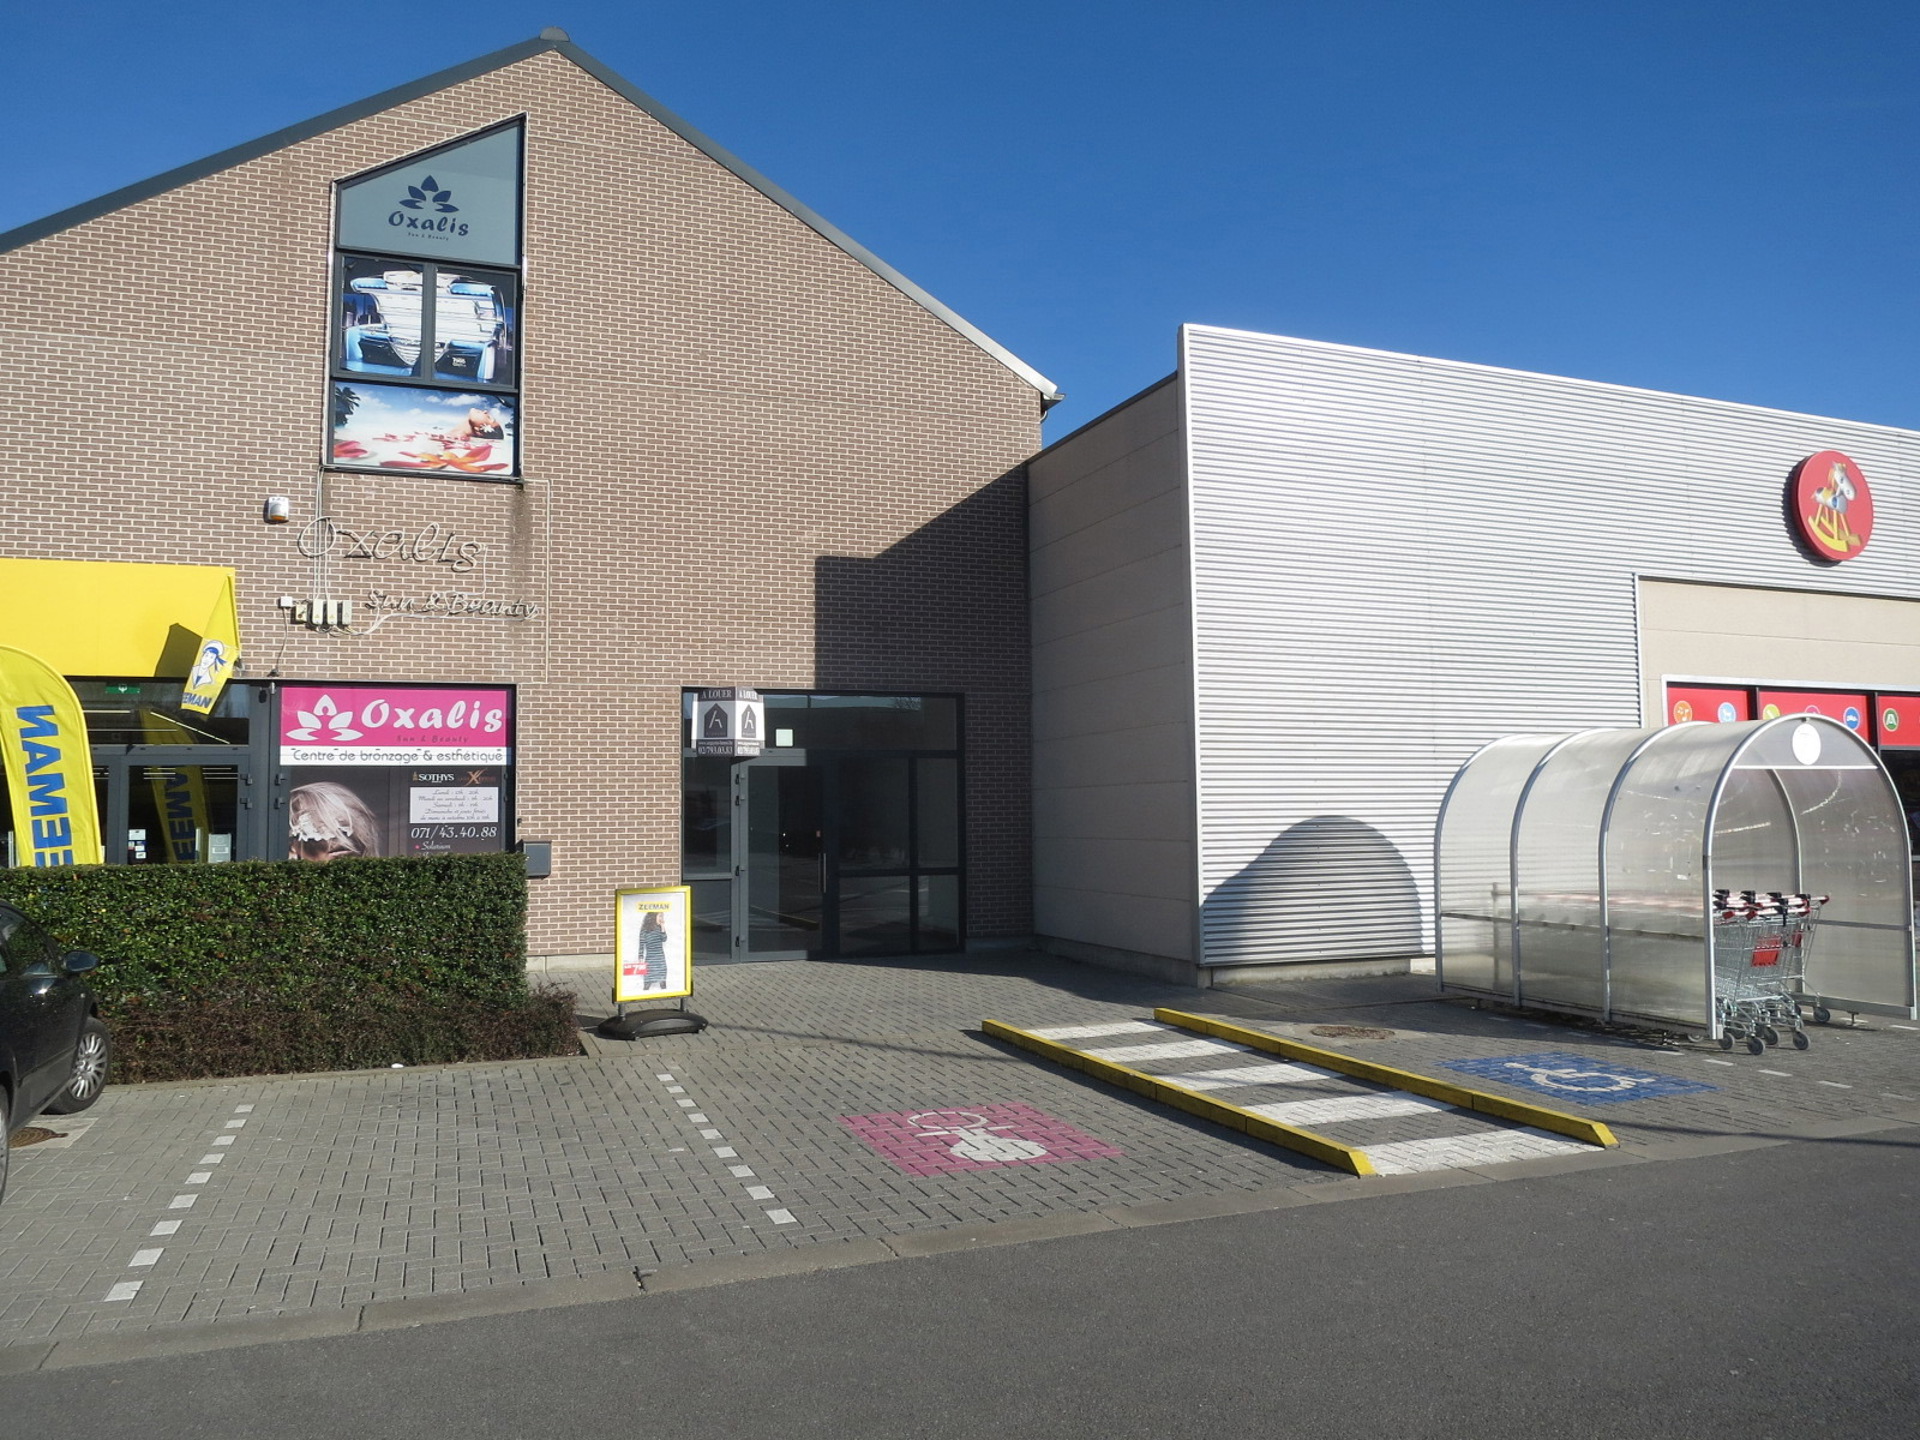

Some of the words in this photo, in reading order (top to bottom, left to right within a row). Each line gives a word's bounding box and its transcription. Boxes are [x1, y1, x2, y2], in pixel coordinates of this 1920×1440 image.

[388, 210, 469, 236] Oxalis
[297, 516, 483, 572] Oxalis
[365, 589, 413, 613] Sun
[445, 592, 540, 620] Beauty
[702, 690, 707, 699] A
[708, 690, 732, 699] LOUER
[361, 699, 503, 733] Oxalis
[293, 749, 335, 761] Centre
[339, 750, 356, 761] de
[360, 750, 418, 763] bronzage
[423, 750, 432, 761] &
[436, 749, 503, 763] esthétique
[418, 773, 455, 782] SOTHYS
[411, 825, 497, 839] 071/43.40.88
